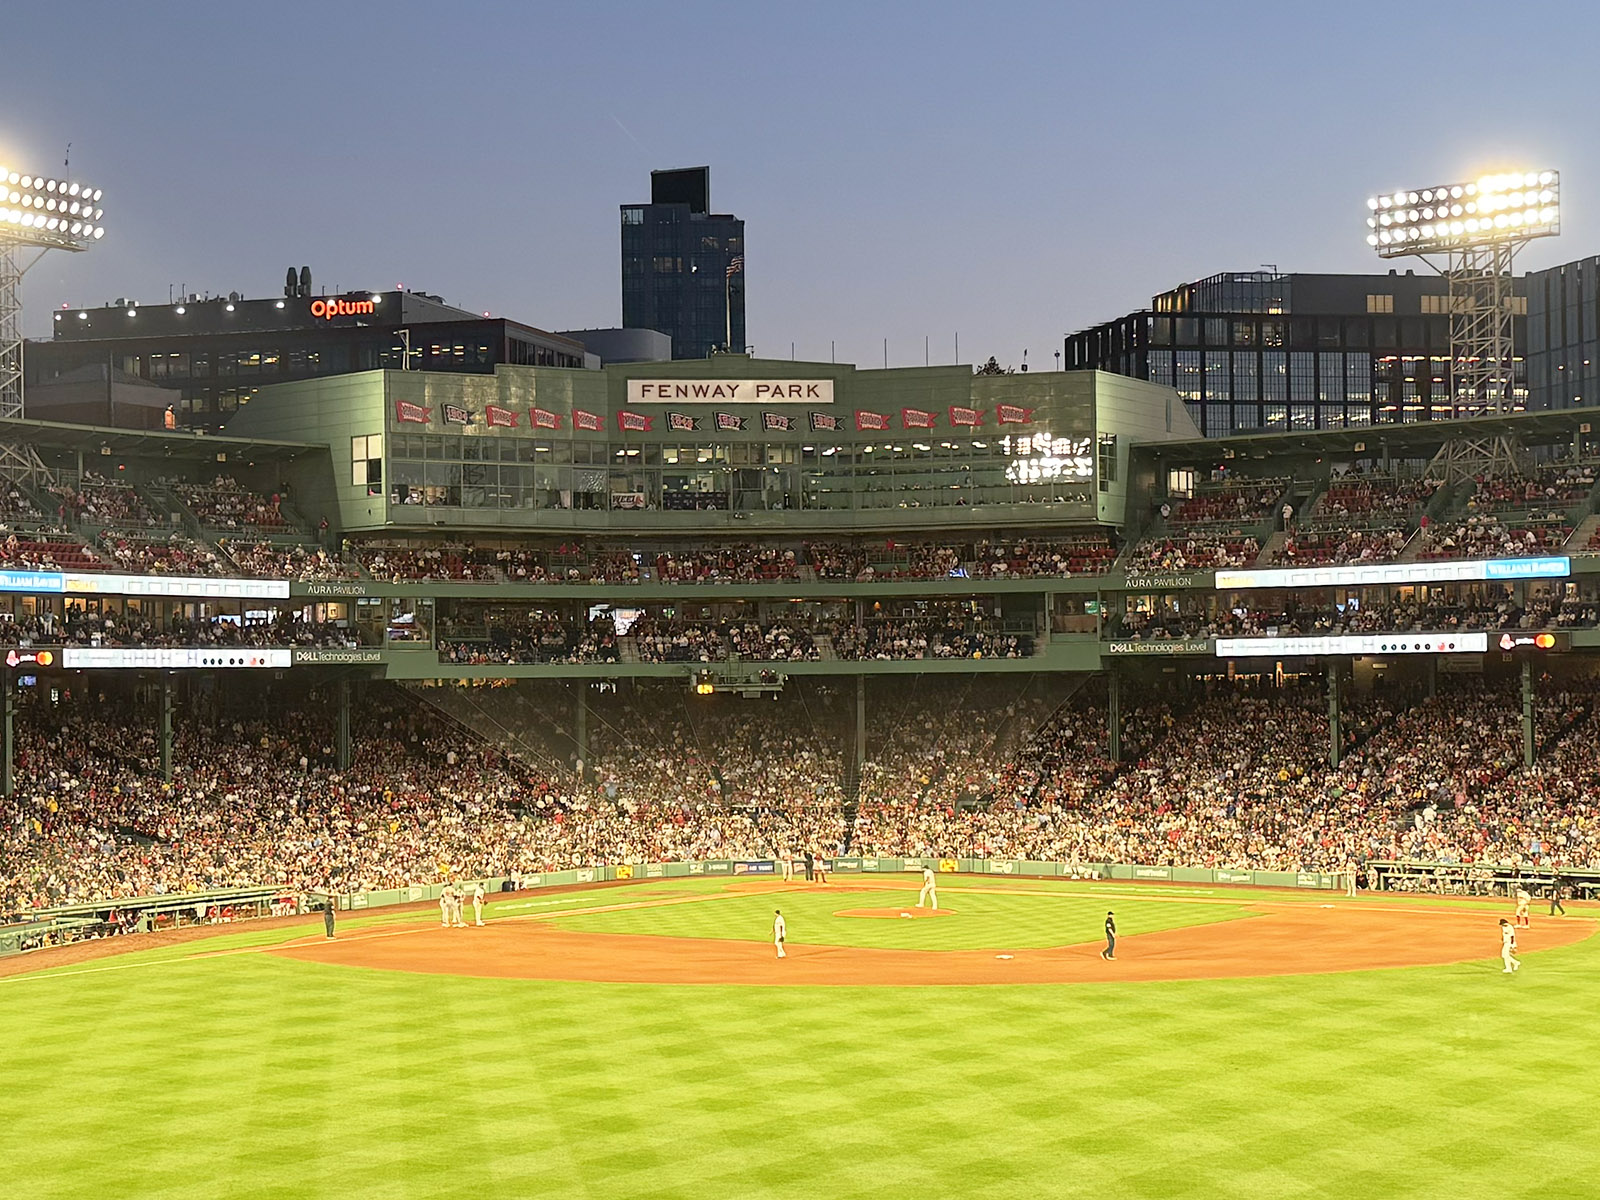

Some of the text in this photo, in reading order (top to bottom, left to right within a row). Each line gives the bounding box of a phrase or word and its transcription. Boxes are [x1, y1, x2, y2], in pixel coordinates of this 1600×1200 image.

[310, 299, 374, 320] Optum
[641, 384, 820, 398] FENWAY PARK
[1153, 577, 1192, 587] PAVILION
[333, 585, 366, 595] PAVILION
[1110, 641, 1207, 654] DELL Technologies Level
[296, 651, 319, 661] DELL
[318, 651, 362, 663] Technologies
